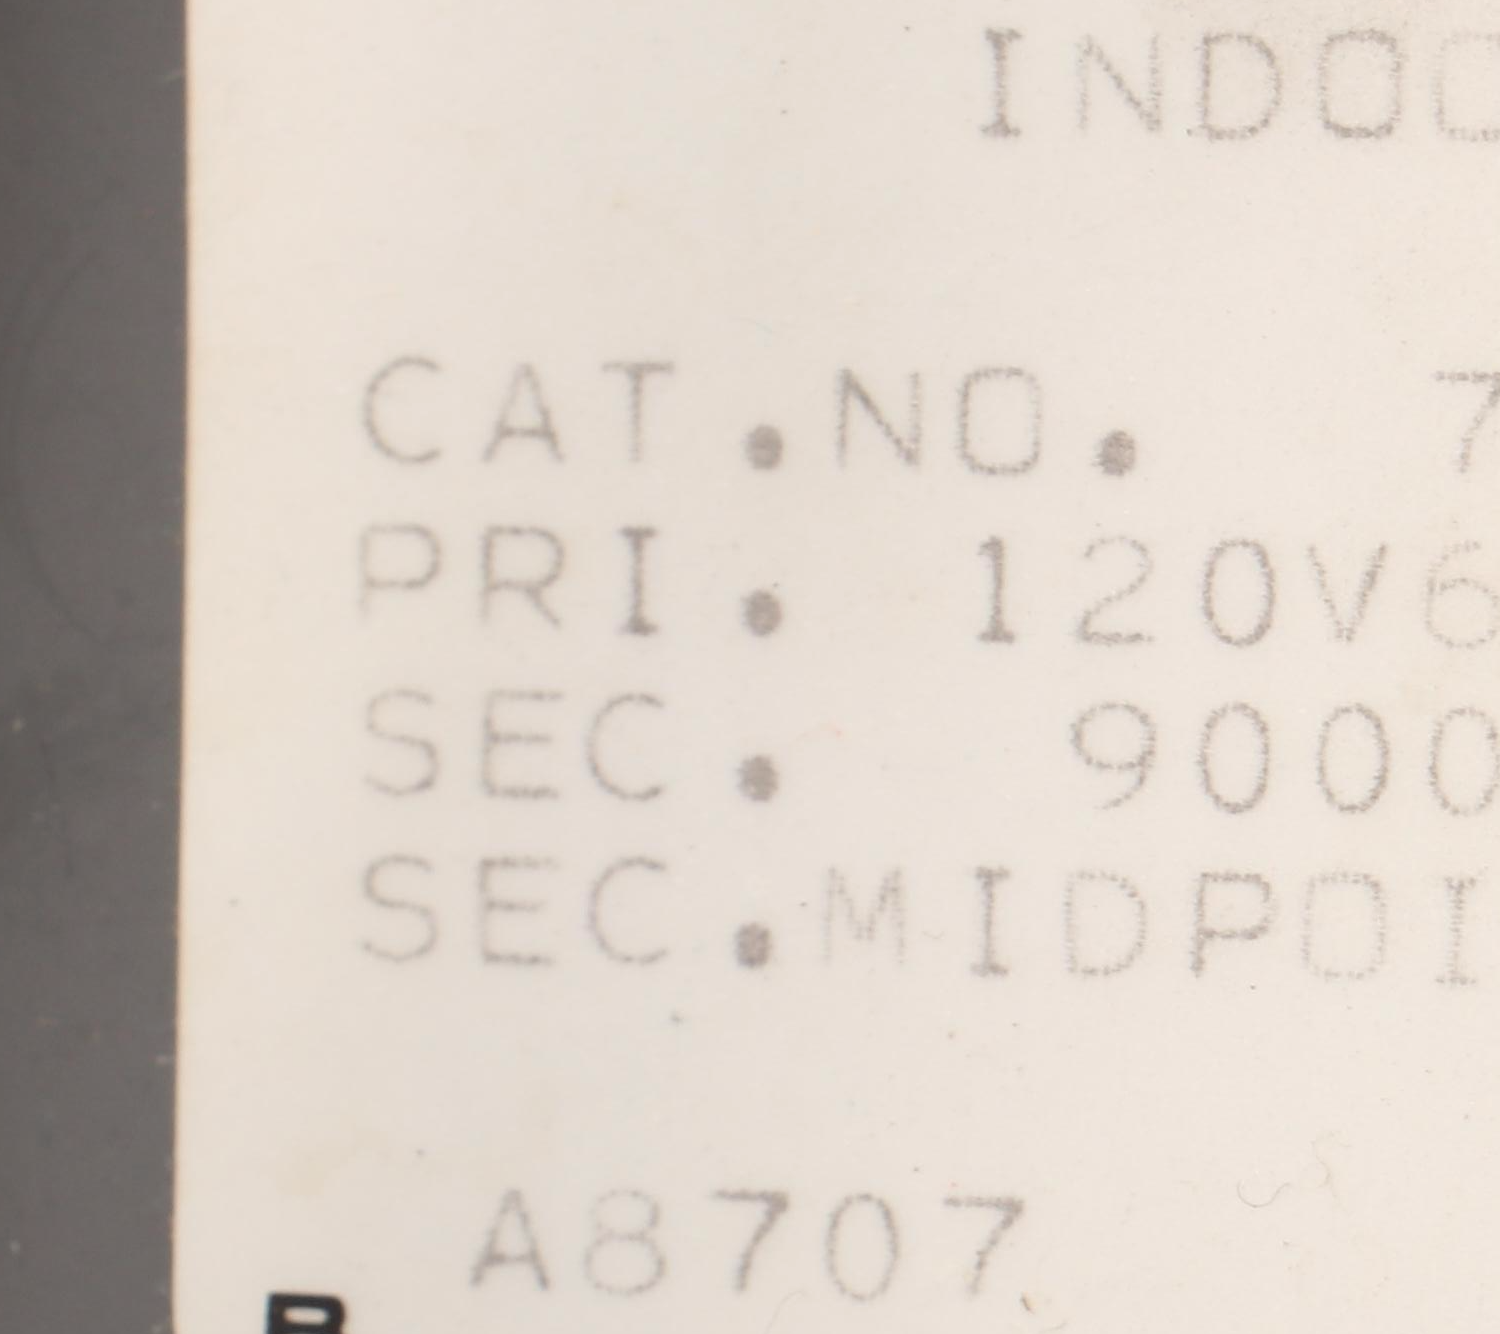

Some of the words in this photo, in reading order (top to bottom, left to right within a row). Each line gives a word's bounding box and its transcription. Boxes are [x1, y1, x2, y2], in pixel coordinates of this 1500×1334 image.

[363, 525, 786, 641] PRI.
[363, 691, 781, 805] SEC.
[469, 1189, 1026, 1303] A8707
